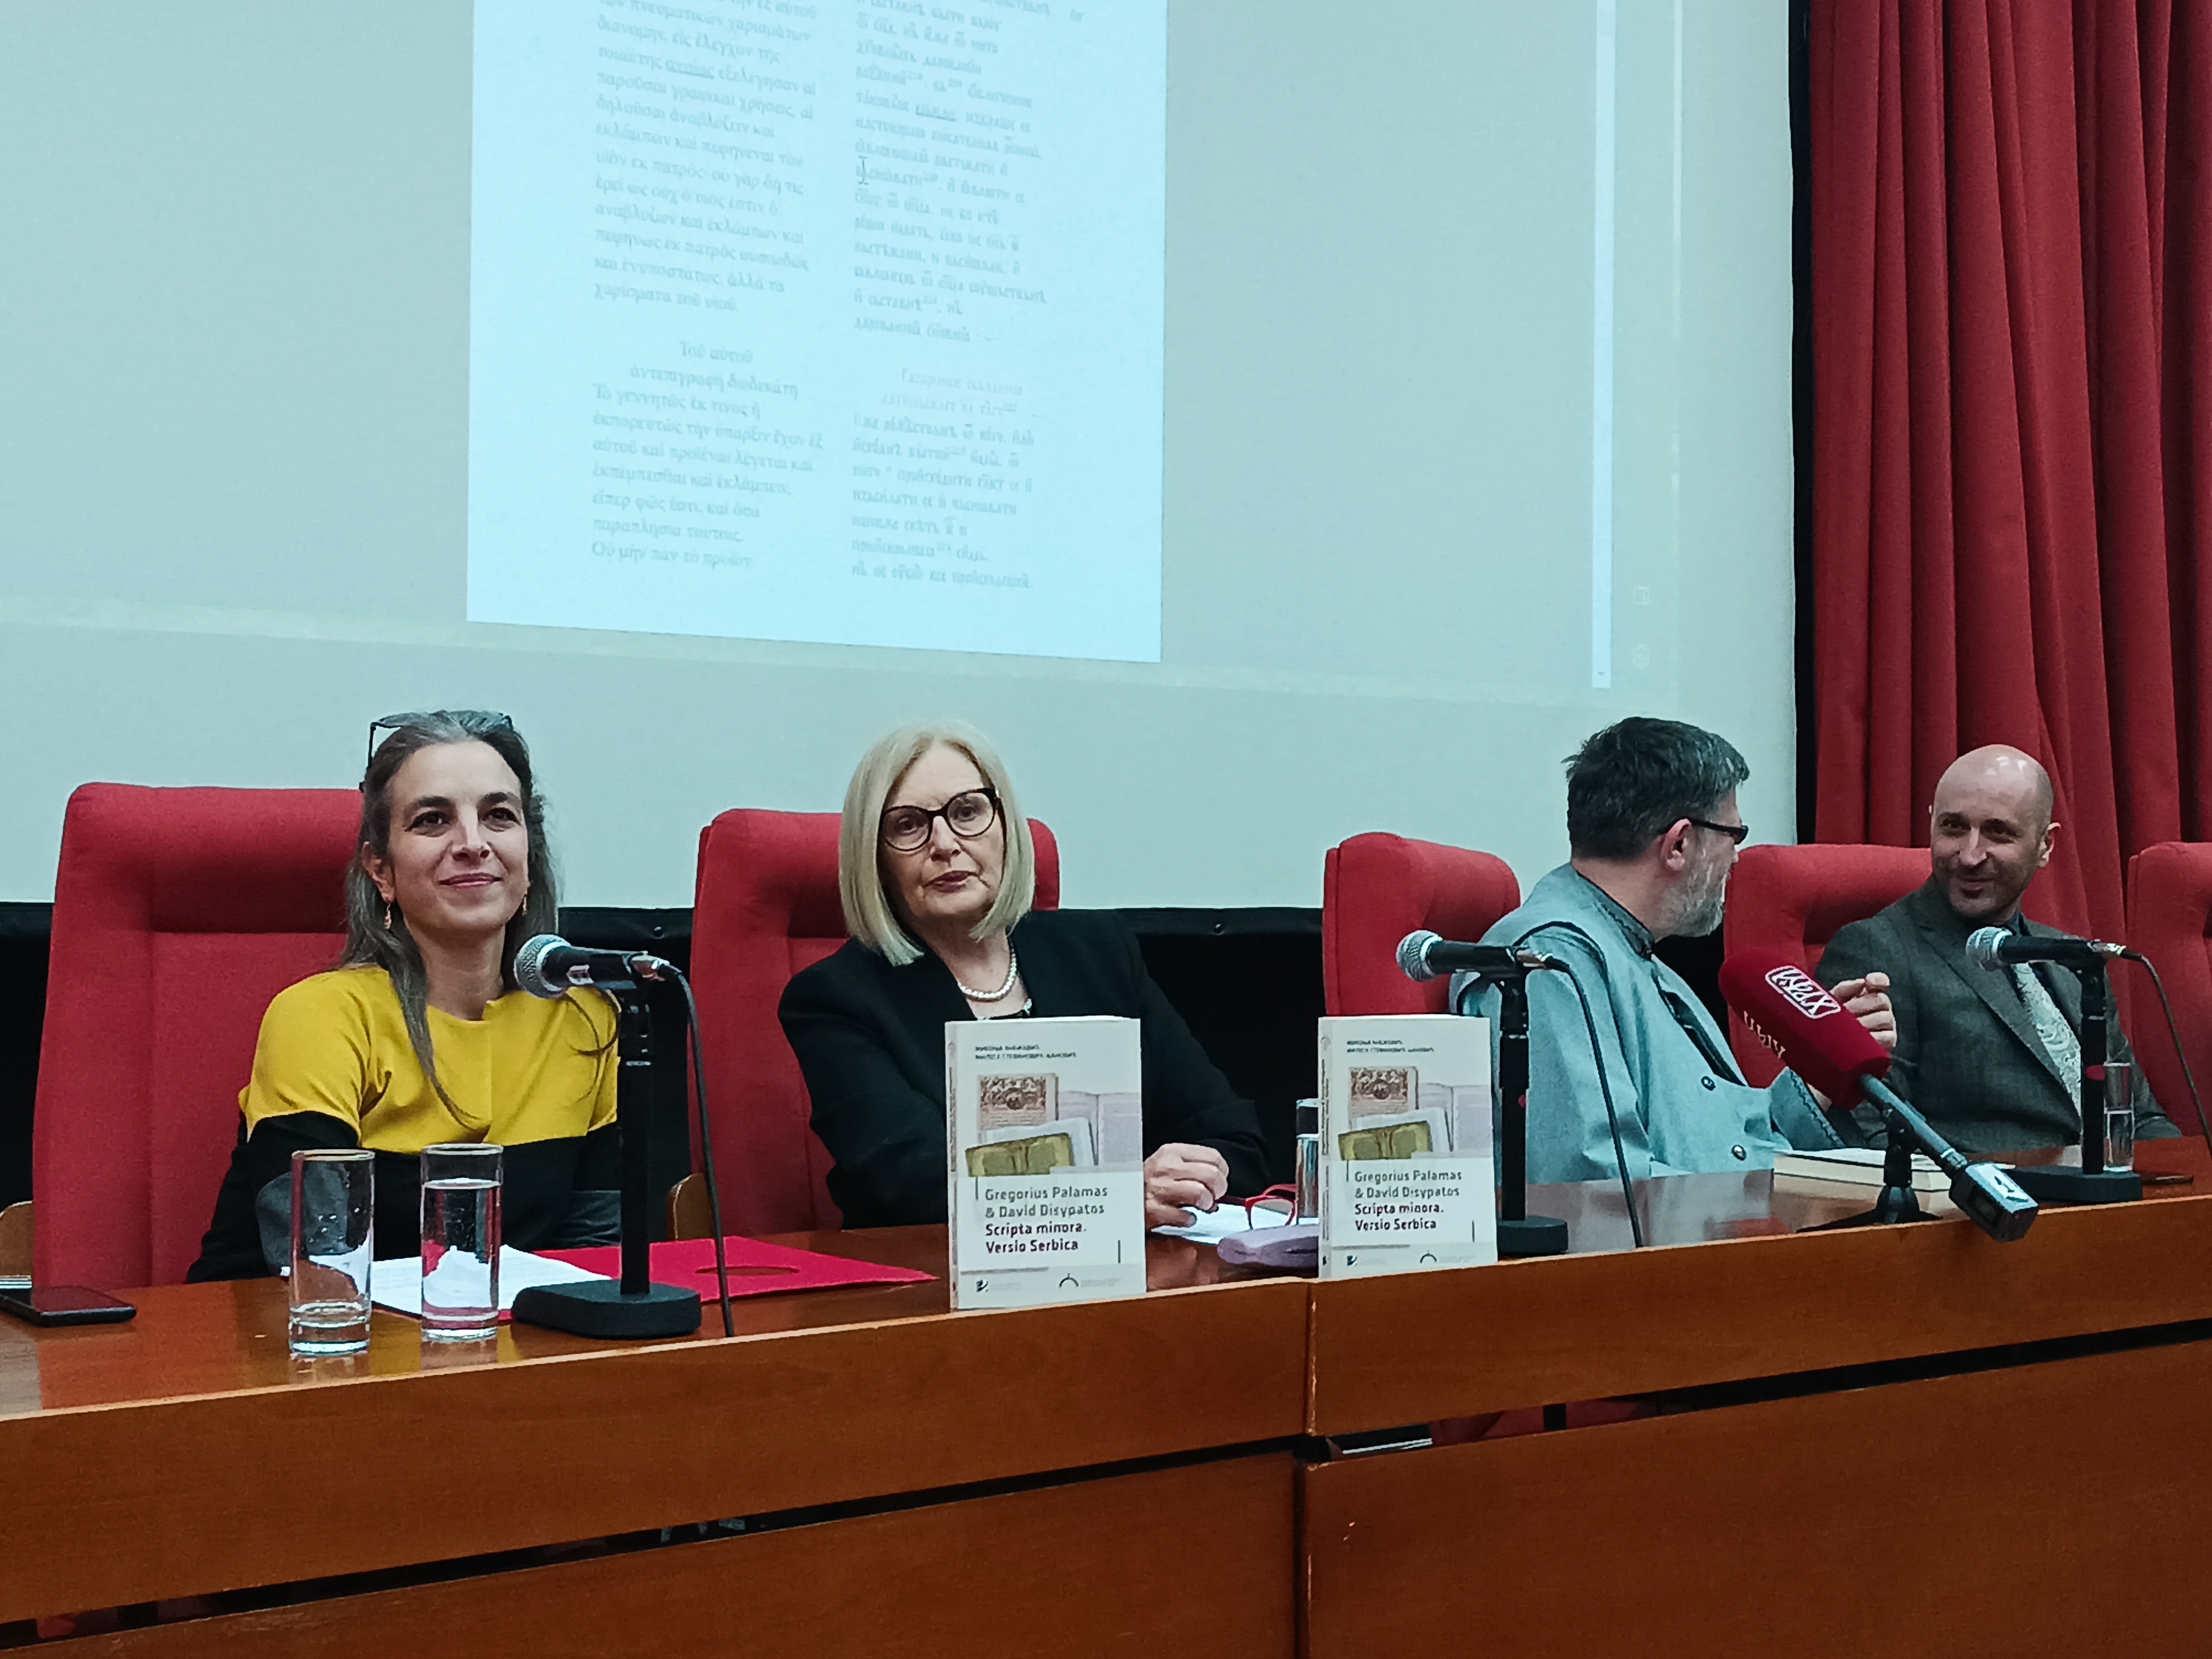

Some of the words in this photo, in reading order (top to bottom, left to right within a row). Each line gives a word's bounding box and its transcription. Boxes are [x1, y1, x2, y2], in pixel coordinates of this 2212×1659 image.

[1354, 1170, 1410, 1185] Gregorius
[1413, 1170, 1463, 1181] Palamas
[985, 1188, 1048, 1203] Gregorius
[1052, 1186, 1108, 1198] Palamas
[1355, 1187, 1364, 1199] &
[1366, 1186, 1399, 1198] David
[1402, 1186, 1460, 1199] Disypatos
[985, 1207, 995, 1218] &
[999, 1204, 1036, 1218] David
[1040, 1203, 1105, 1218] Disypatos
[1354, 1202, 1396, 1217] Scripta
[1399, 1201, 1444, 1214] minora.
[985, 1222, 1032, 1238] Scripta
[1036, 1221, 1087, 1234] minora.
[1355, 1218, 1391, 1231] Versio
[1394, 1217, 1437, 1230] Serbica
[985, 1239, 1026, 1254] Versio
[1030, 1238, 1079, 1253] Serbica
